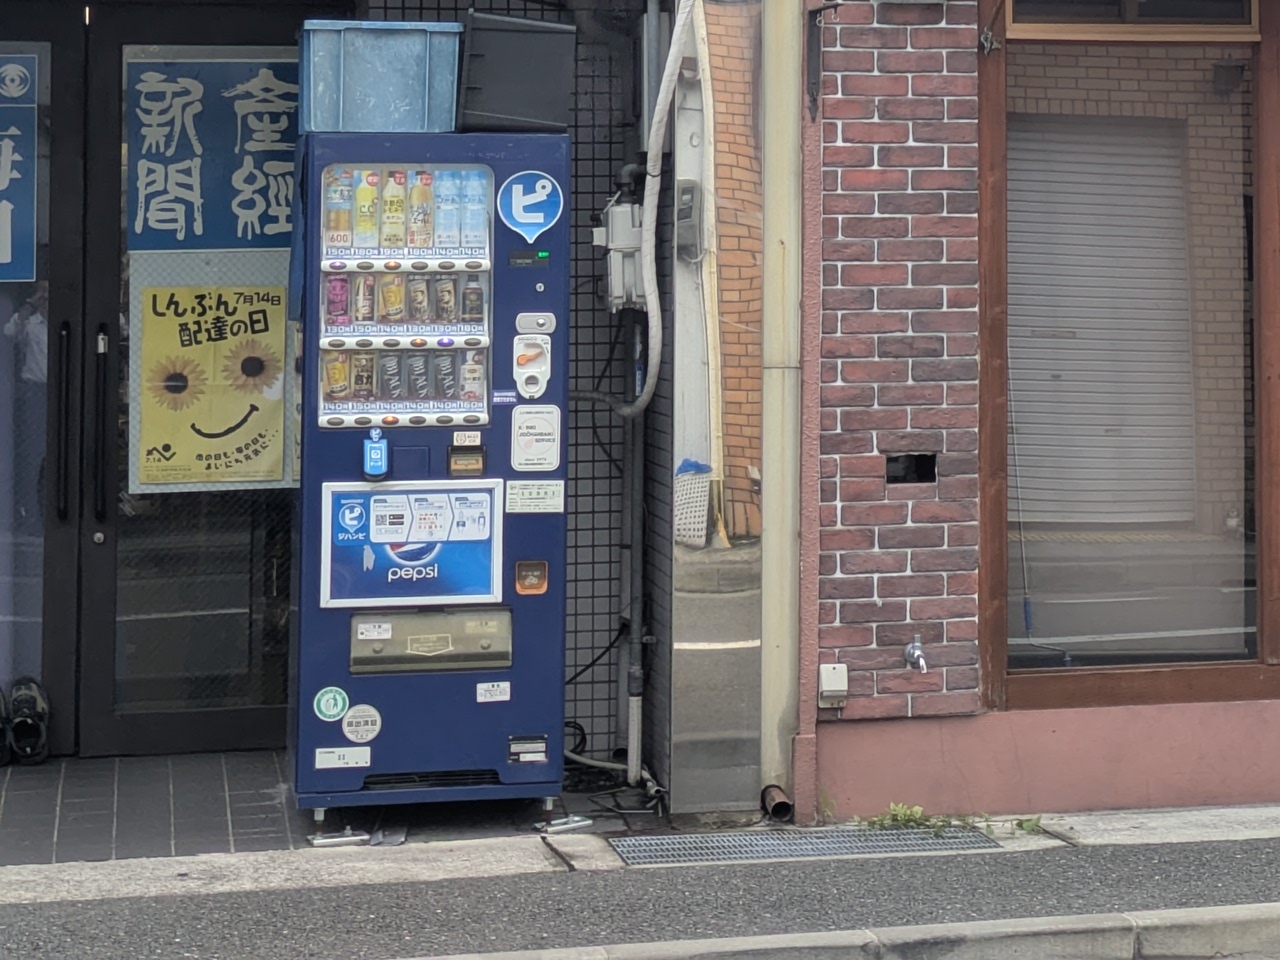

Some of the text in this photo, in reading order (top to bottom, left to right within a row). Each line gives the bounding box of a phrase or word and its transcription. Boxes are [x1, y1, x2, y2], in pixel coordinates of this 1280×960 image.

[152, 292, 238, 317] しんぶん
[233, 291, 281, 307] 7月14日
[178, 308, 270, 348] 配達の日
[387, 563, 439, 583] pepsi
